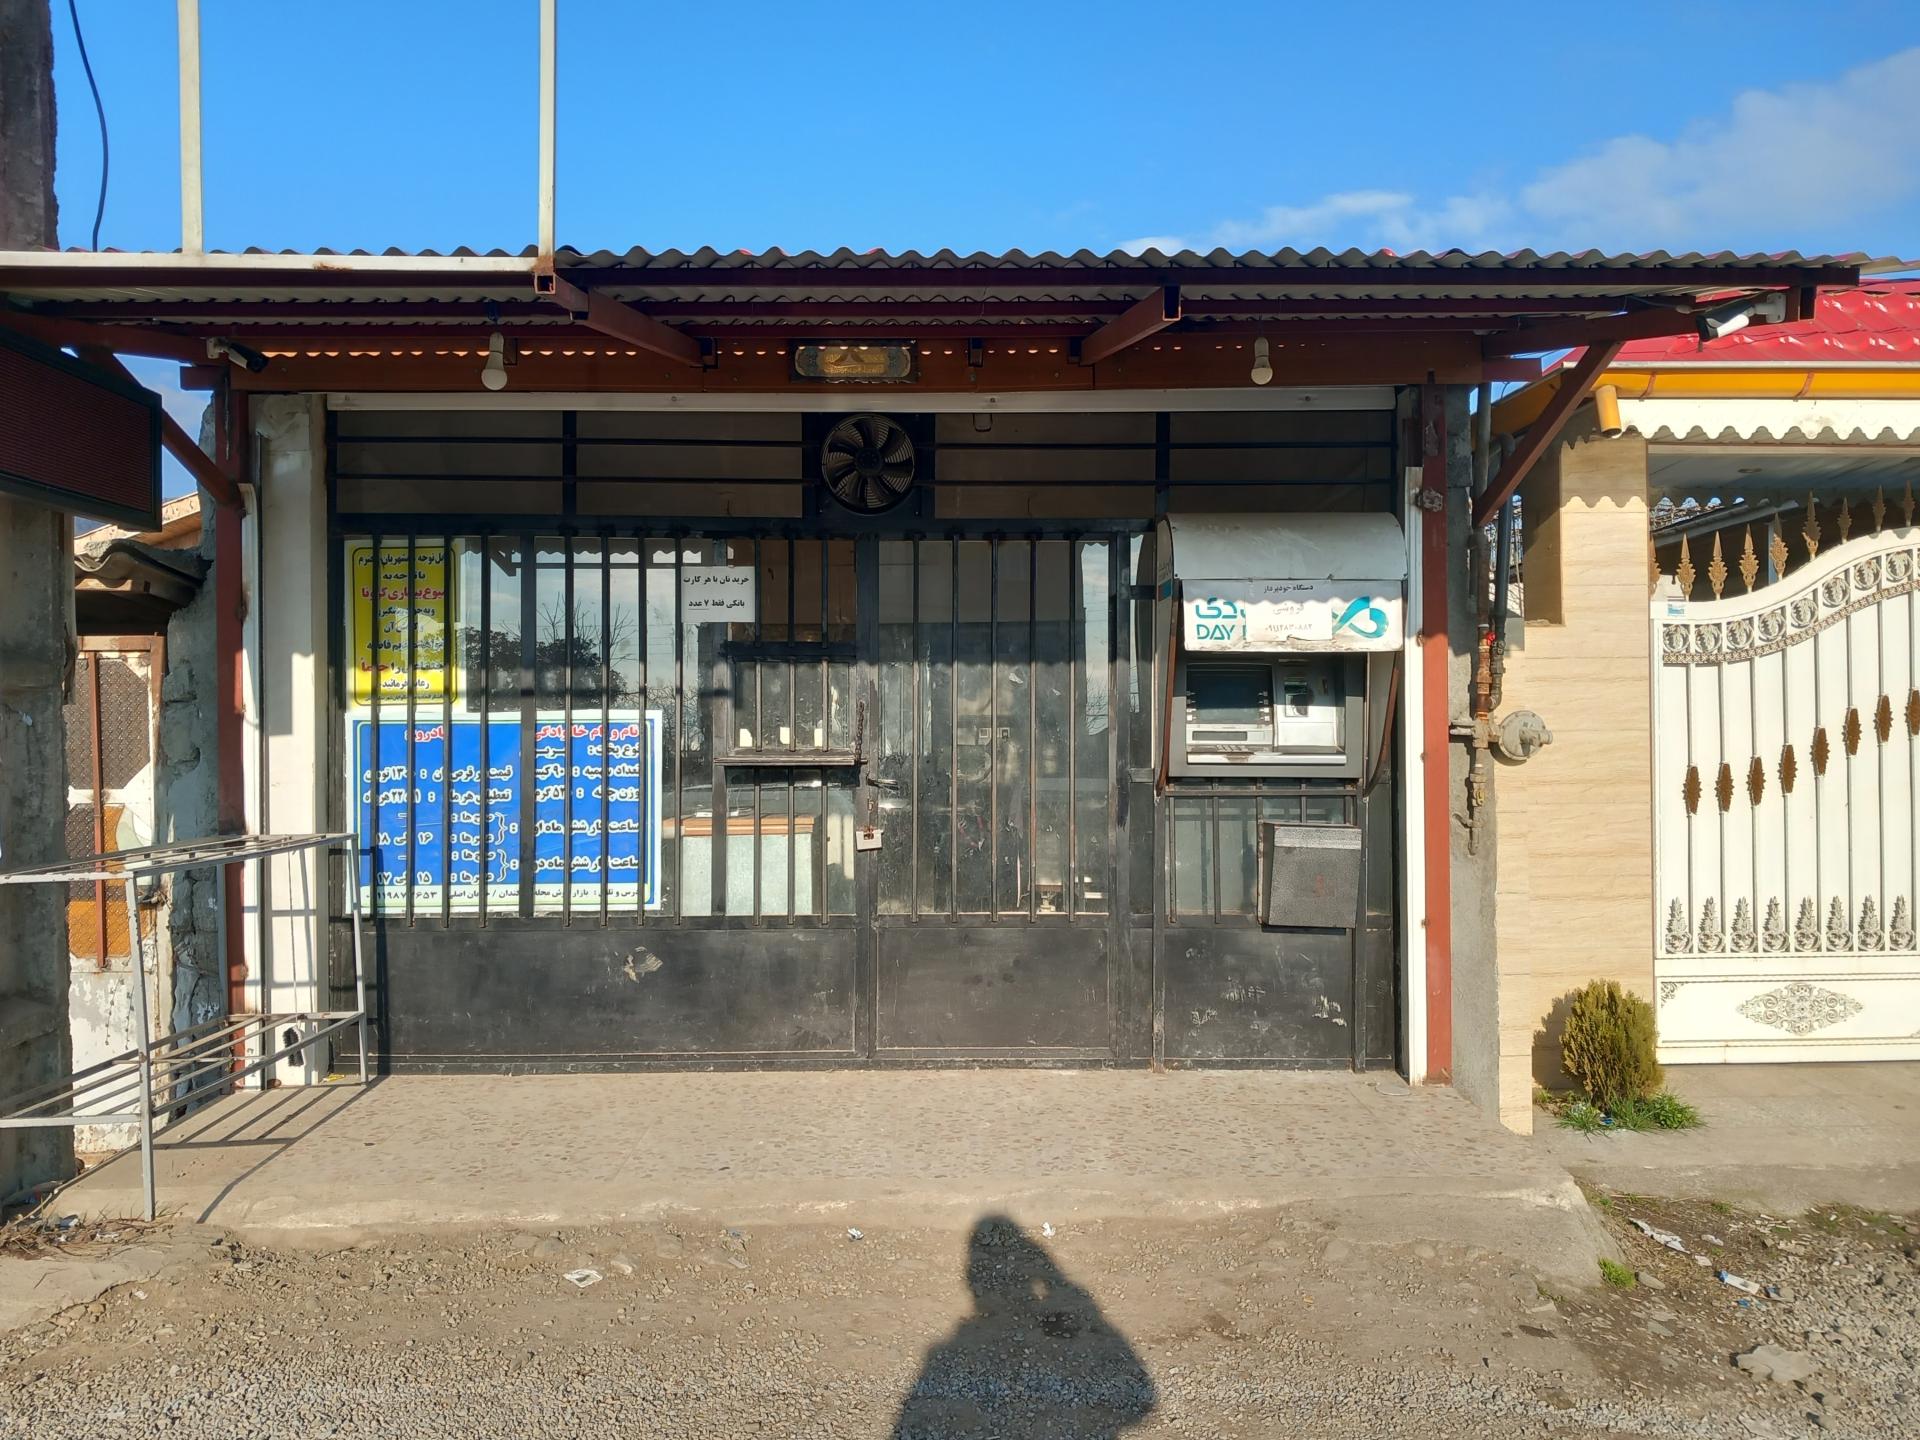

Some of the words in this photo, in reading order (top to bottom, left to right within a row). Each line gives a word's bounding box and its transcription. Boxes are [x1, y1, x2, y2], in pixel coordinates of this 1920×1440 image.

[683, 575, 701, 585] کارت
[704, 576, 711, 585] هر
[713, 575, 718, 583] با
[719, 575, 731, 585] نان
[732, 576, 749, 585] خرید
[1263, 585, 1292, 593] خودپرداز
[1292, 584, 1314, 592] دستگاه
[704, 599, 710, 607] ۷
[711, 599, 724, 607] فقط
[726, 599, 745, 608] بانکی
[1196, 624, 1235, 641] DAY
[610, 729, 619, 740] و
[620, 725, 639, 740] نام
[418, 832, 433, 845] ۱۶
[418, 871, 431, 884] ۱۵
